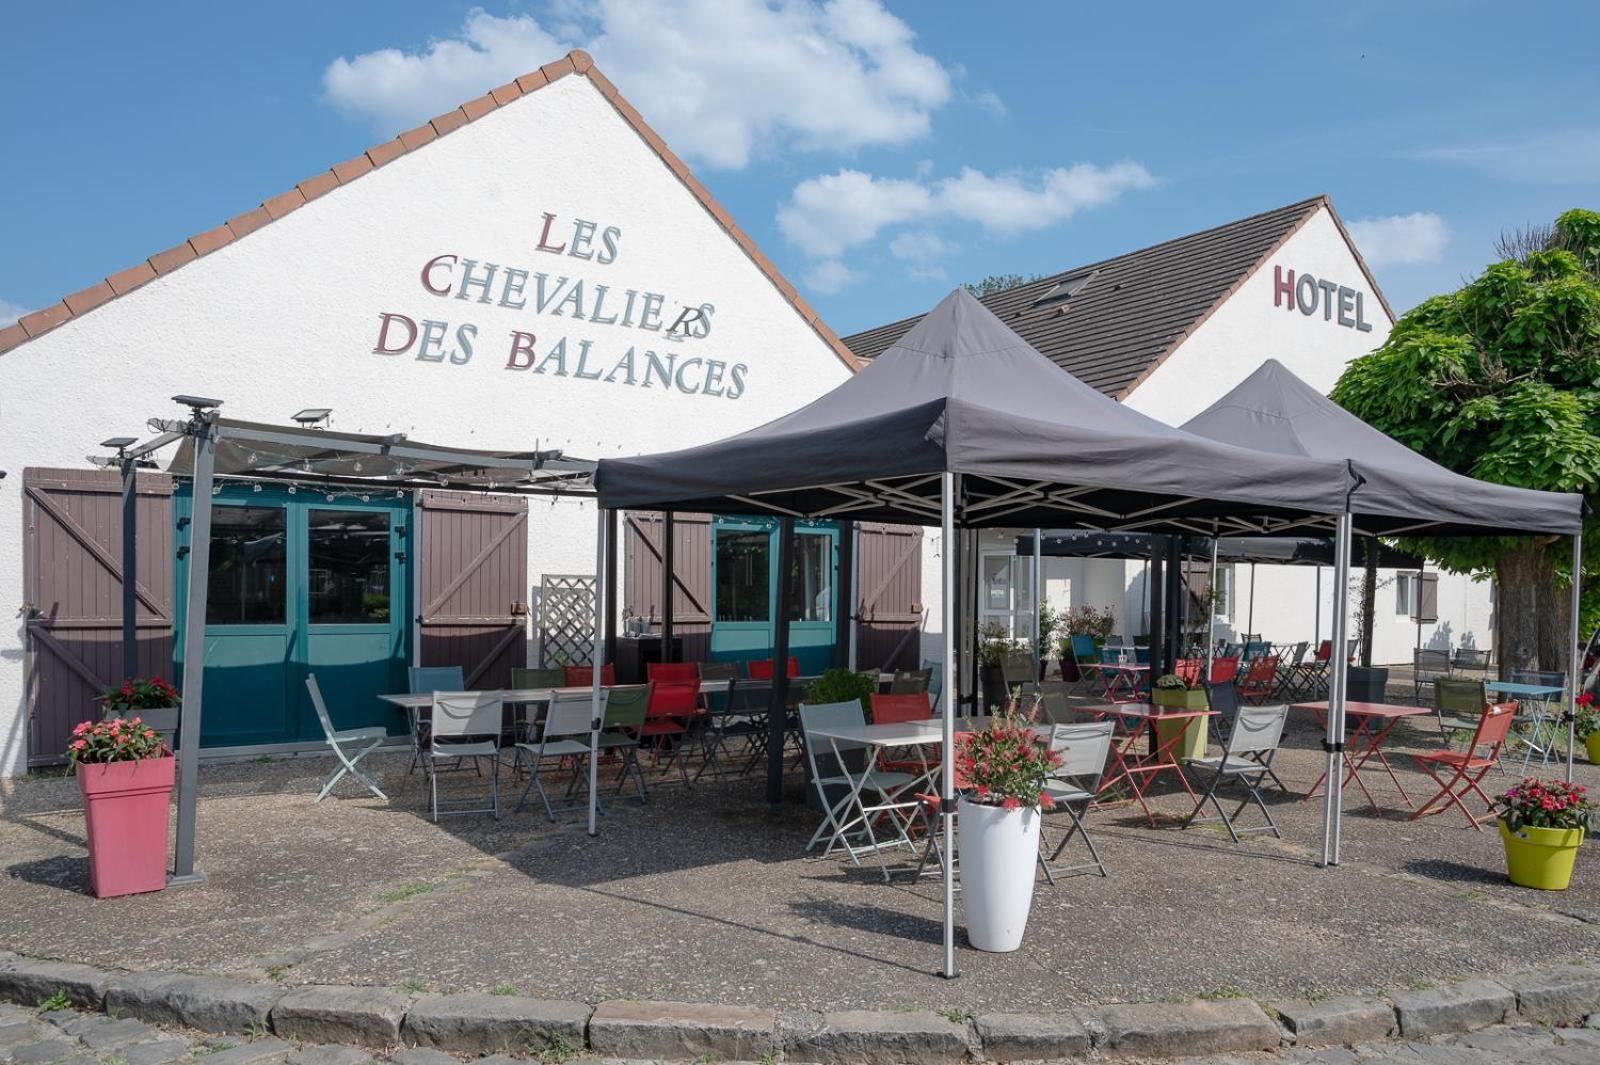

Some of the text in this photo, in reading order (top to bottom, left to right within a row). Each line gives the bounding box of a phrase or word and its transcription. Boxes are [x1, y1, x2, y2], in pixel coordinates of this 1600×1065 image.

[536, 211, 621, 265] LES
[420, 253, 715, 342] CHEVALIERS
[1274, 265, 1372, 332] HOTEL
[372, 312, 748, 400] DES BALANCES
